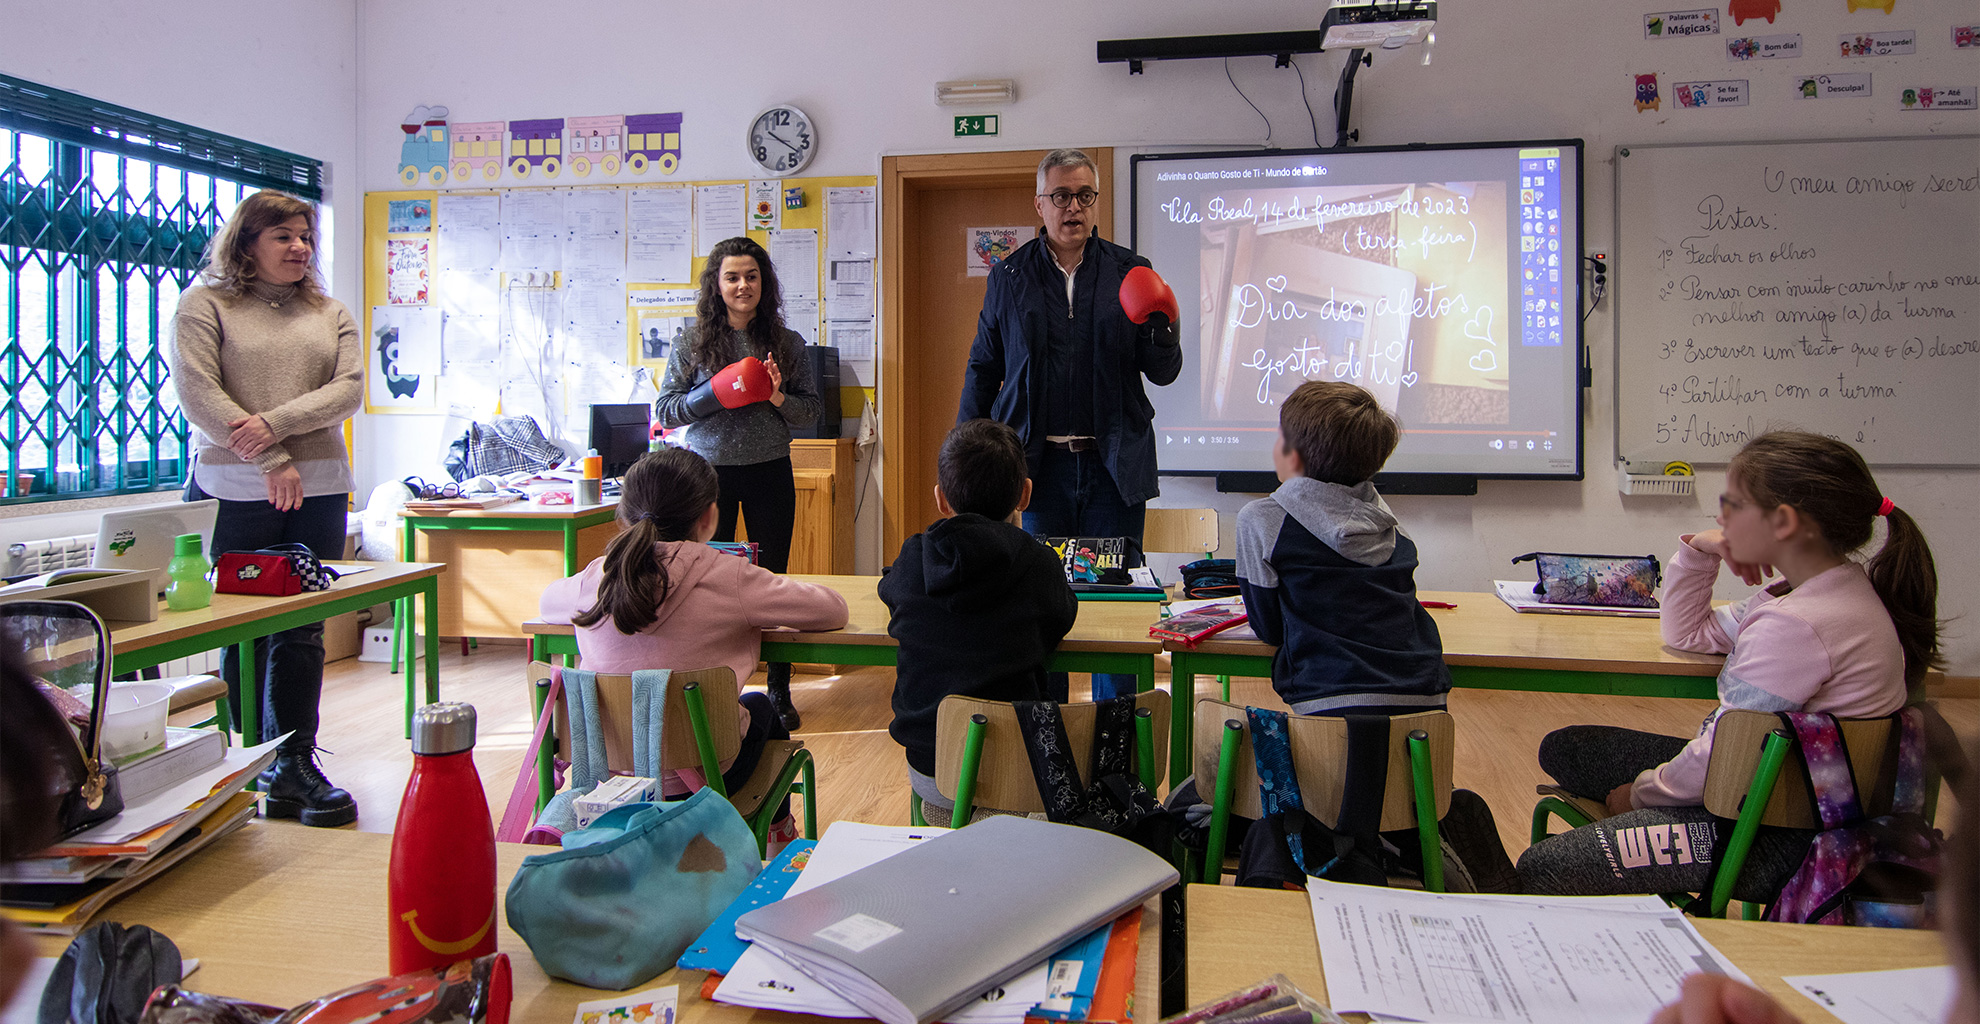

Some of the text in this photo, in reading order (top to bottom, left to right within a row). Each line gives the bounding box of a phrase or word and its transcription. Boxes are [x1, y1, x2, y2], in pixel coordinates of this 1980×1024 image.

[1668, 13, 1699, 21] Palavras
[1667, 24, 1711, 36] Mágicas
[1782, 42, 1798, 50] dia!
[1876, 38, 1913, 48] Boa tarde!
[1717, 85, 1739, 94] Se faz
[1827, 84, 1865, 94] Desculpa!
[1947, 89, 1961, 97] Até
[1717, 95, 1740, 103] favor!
[1937, 99, 1971, 107] amanhã!
[762, 115, 776, 131] 11
[773, 110, 790, 126] 12
[796, 121, 807, 138] 2
[800, 133, 810, 150] 3
[756, 146, 768, 162] 8
[788, 152, 799, 168] 5
[775, 155, 786, 172] 6
[1156, 172, 1187, 182] Adivinha
[1194, 170, 1219, 181] Quanto
[1220, 169, 1242, 180] Gosto
[1242, 168, 1252, 179] de
[1252, 168, 1261, 178] Ti
[1265, 167, 1291, 177] Mundo
[1291, 166, 1302, 177] de
[1790, 177, 1838, 195] meu
[1846, 172, 1917, 209] amigo
[1922, 167, 1980, 193] secret
[1160, 189, 1470, 234] Vila Real, 14 de fevereiro de 2023
[1697, 194, 1778, 232] Pistas:
[975, 229, 1018, 238] Bem-Vindos!
[1679, 235, 1744, 265] Fechar
[1748, 251, 1764, 264] os
[1769, 242, 1816, 262] olhos
[1679, 274, 1741, 301] Pensar
[1747, 284, 1781, 299] com
[1838, 271, 1910, 296] carinho
[1913, 278, 1939, 293] no
[636, 296, 666, 304] Delegados
[1229, 281, 1470, 341] Dia dos afetos
[1692, 301, 1764, 327] melhor
[1775, 305, 1838, 339] amigo
[1842, 302, 1867, 325] (a)
[1870, 300, 1892, 323] da
[1684, 338, 1755, 364] Escrever
[1763, 345, 1796, 361] um
[1798, 335, 1844, 356] texto
[1851, 342, 1879, 368] que
[1884, 345, 1898, 358] o
[1901, 336, 1924, 360] (a)
[1928, 335, 1980, 358] descre
[1334, 341, 1362, 380] de
[1681, 374, 1768, 406] Partilhar
[1774, 383, 1810, 400] com
[1818, 387, 1829, 398] a
[1210, 436, 1223, 444] 3:50
[1226, 436, 1240, 444] 3:56
[1063, 538, 1077, 583] CATCH
[1095, 554, 1124, 570] ALL!
[1594, 826, 1624, 879] LOVELYGIRLS
